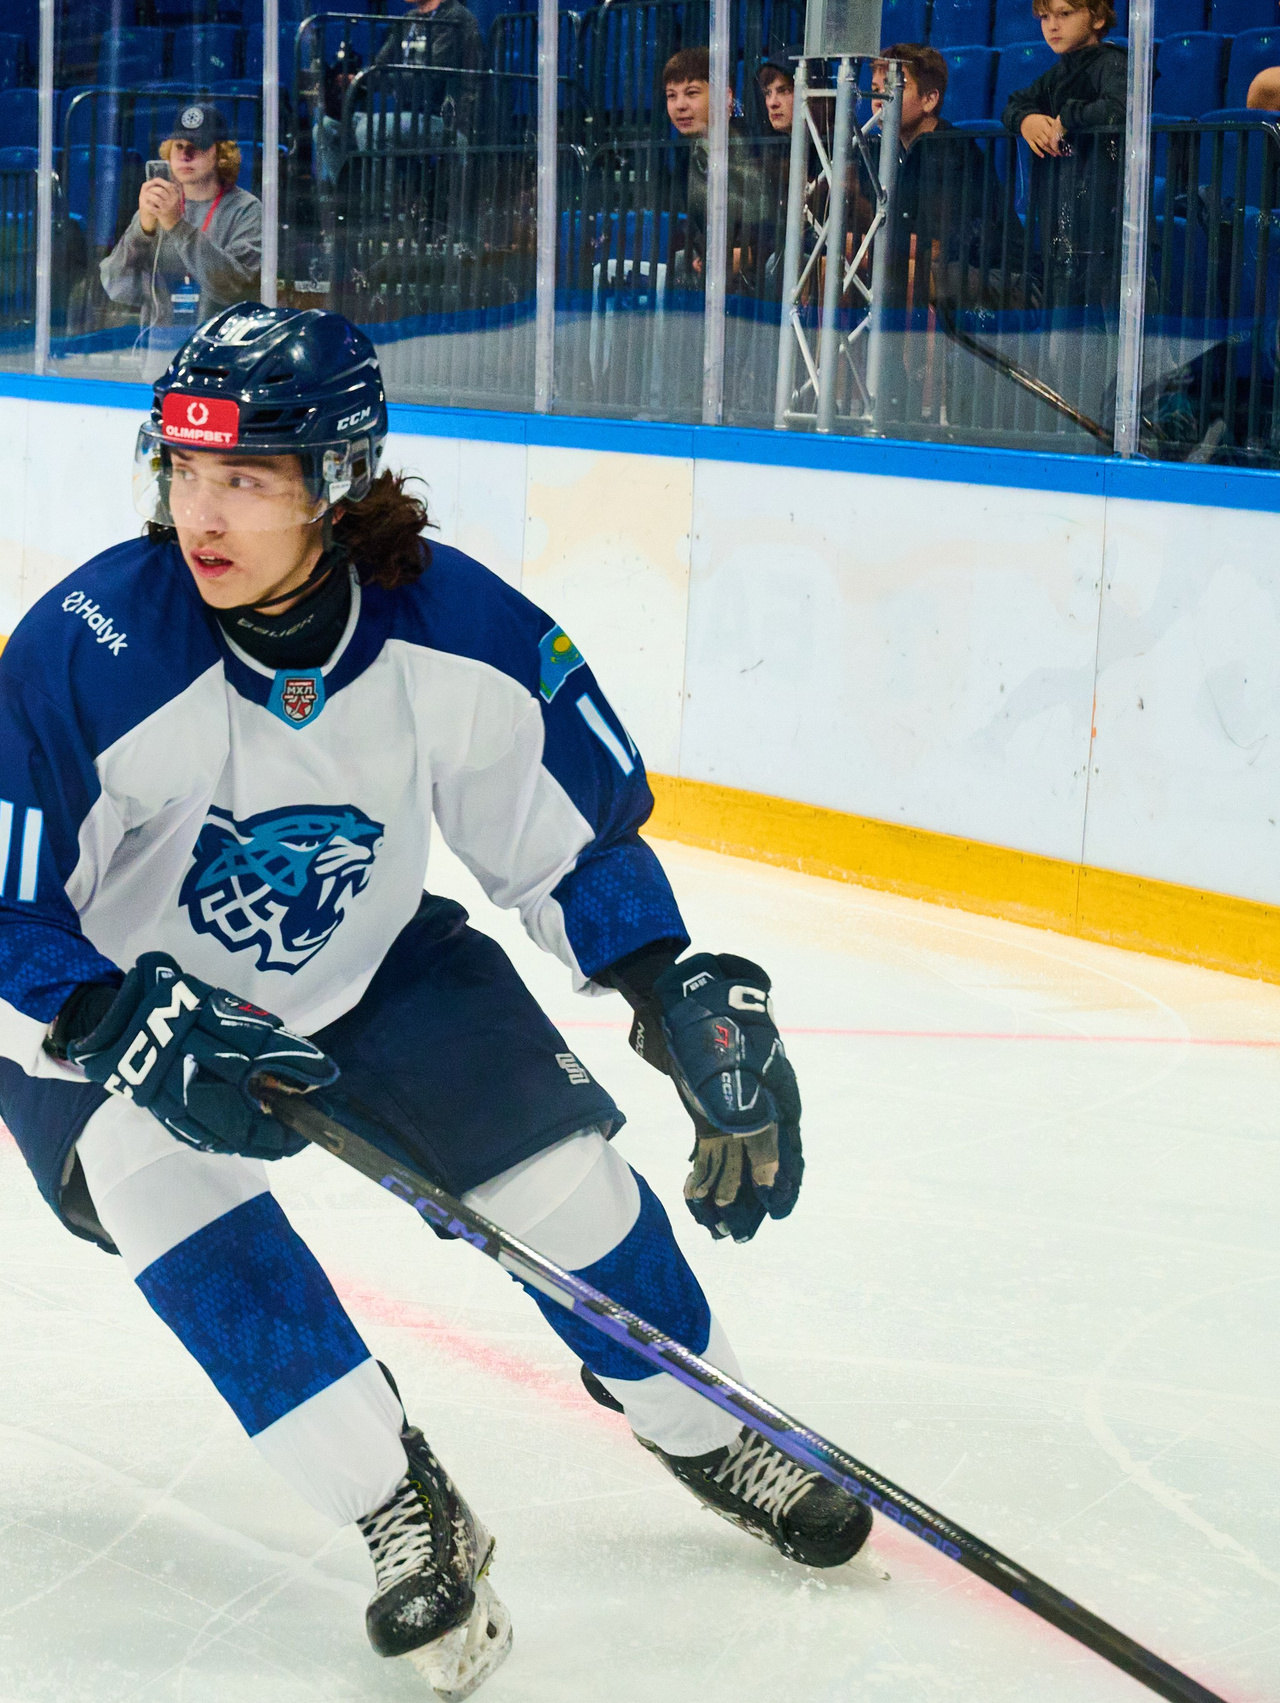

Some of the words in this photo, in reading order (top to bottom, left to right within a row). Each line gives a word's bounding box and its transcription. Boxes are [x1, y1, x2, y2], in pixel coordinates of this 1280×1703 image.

[337, 406, 371, 432] CCM
[165, 425, 234, 443] OLIMPBET
[77, 598, 128, 656] Halyk
[287, 686, 313, 695] МХЛ
[380, 1174, 489, 1251] CCM
